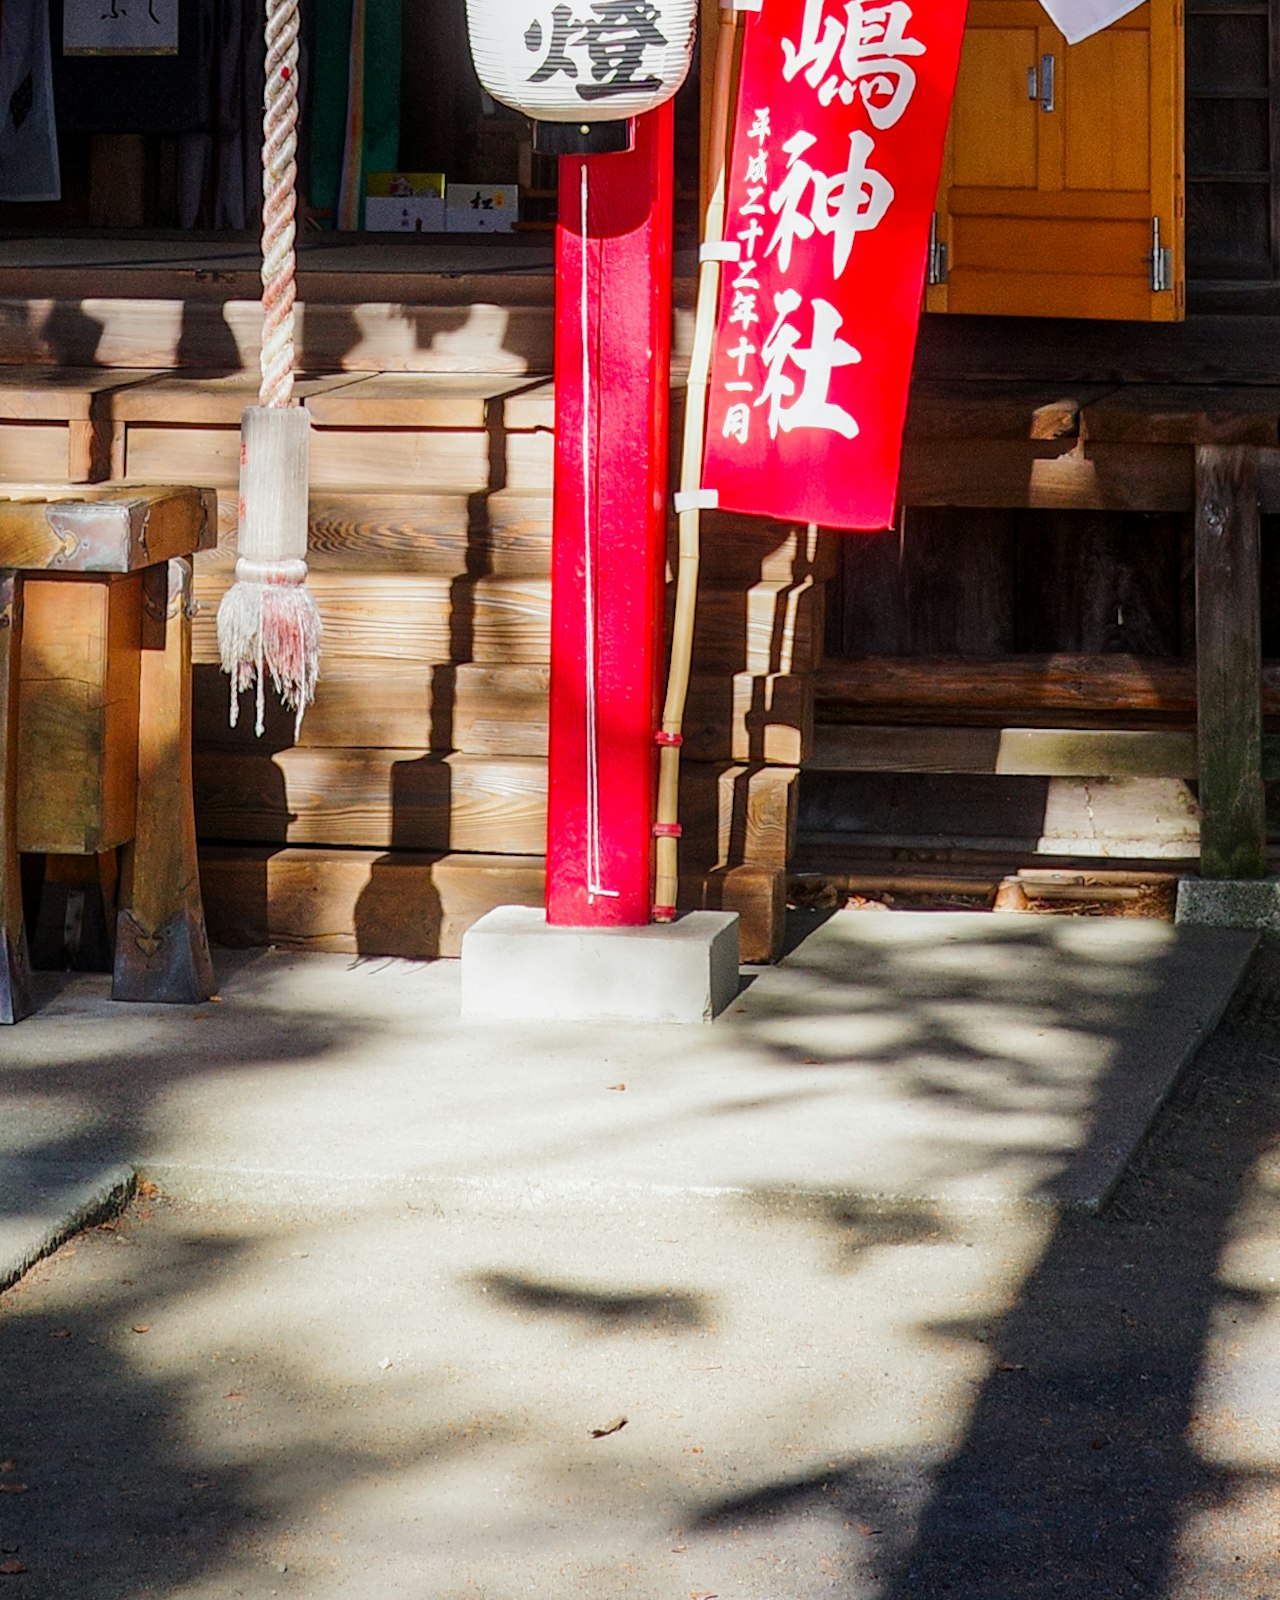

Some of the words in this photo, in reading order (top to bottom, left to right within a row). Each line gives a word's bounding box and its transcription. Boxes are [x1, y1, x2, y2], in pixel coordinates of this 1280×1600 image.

[721, 107, 772, 445] 平成二十二年十一月
